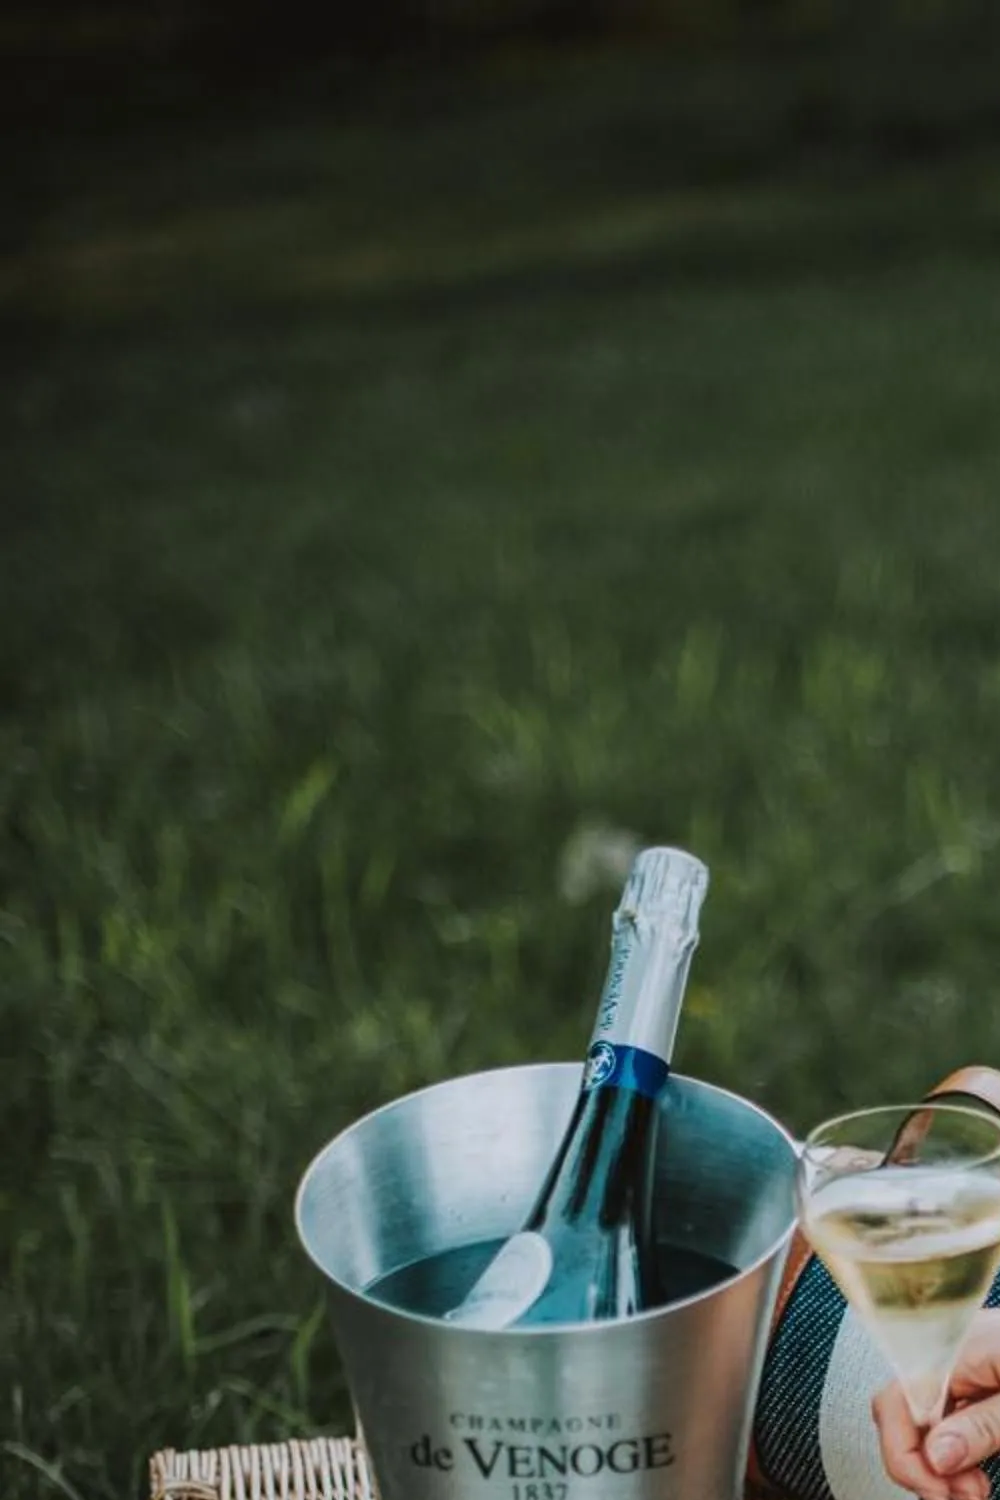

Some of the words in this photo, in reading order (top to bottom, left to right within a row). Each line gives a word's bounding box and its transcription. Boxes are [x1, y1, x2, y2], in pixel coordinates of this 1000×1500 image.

[449, 1412, 622, 1434] CHAMPAGNE
[410, 1433, 454, 1472] de
[463, 1432, 676, 1480] VENOGE
